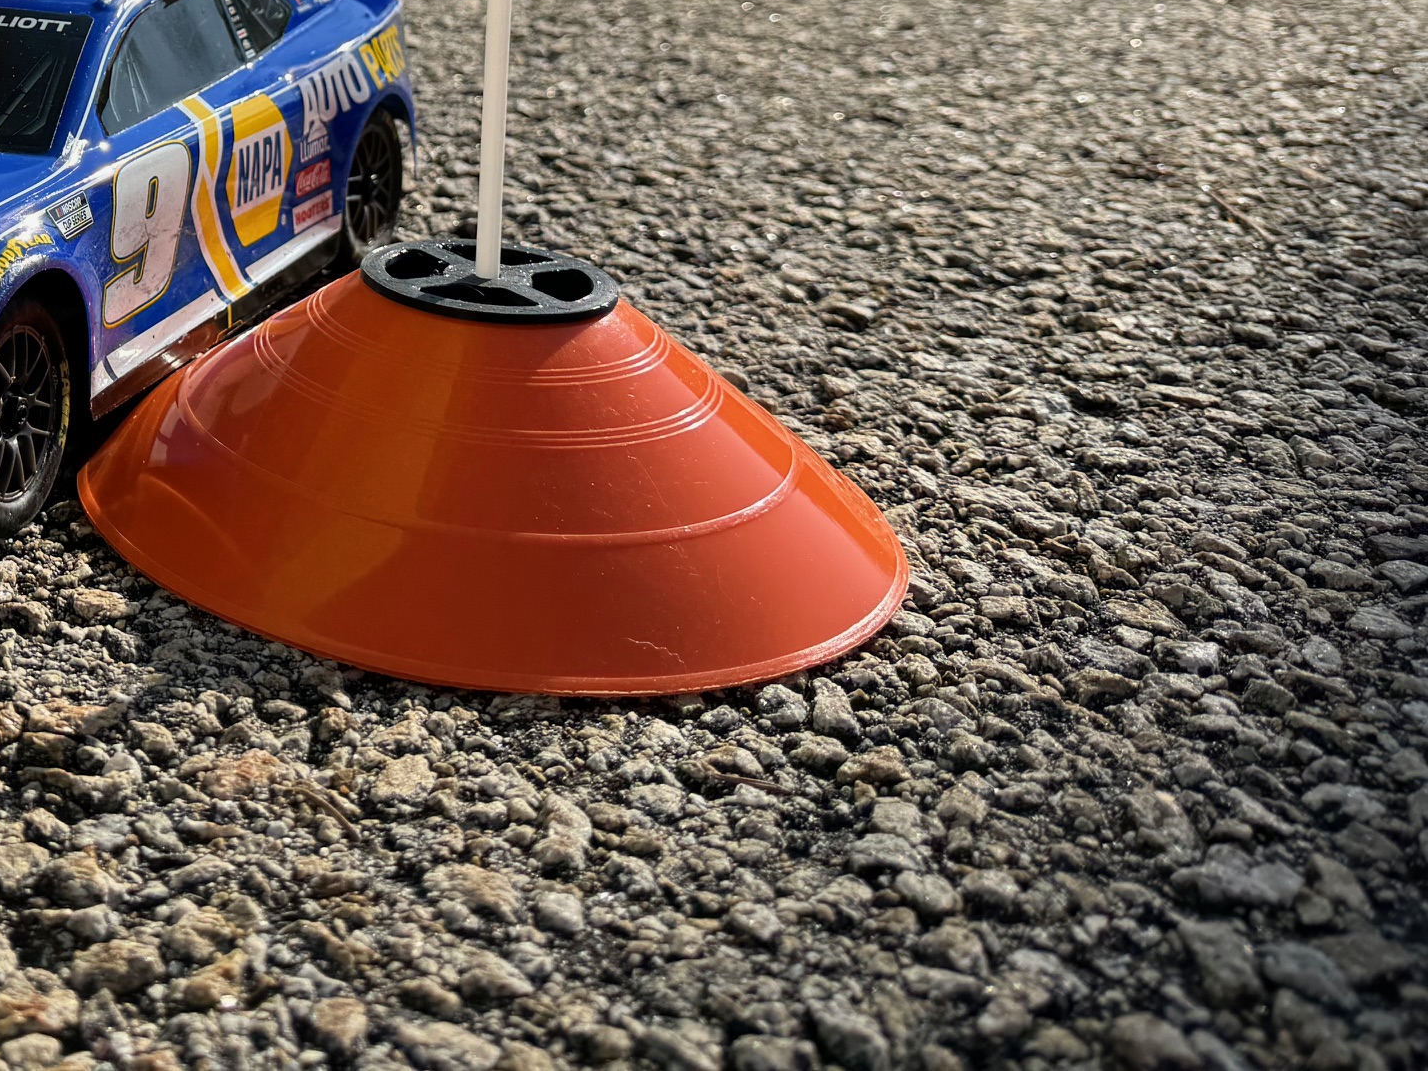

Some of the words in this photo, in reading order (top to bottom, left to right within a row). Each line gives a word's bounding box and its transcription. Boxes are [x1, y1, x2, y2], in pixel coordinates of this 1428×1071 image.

[298, 50, 370, 142] AUTO
[359, 25, 406, 90] PARTS
[237, 130, 282, 208] NAPA
[61, 196, 83, 215] NASCAR
[62, 218, 72, 231] CUP
[71, 210, 87, 226] SERIES
[295, 199, 330, 226] HOOTERS
[102, 139, 191, 328] 9
